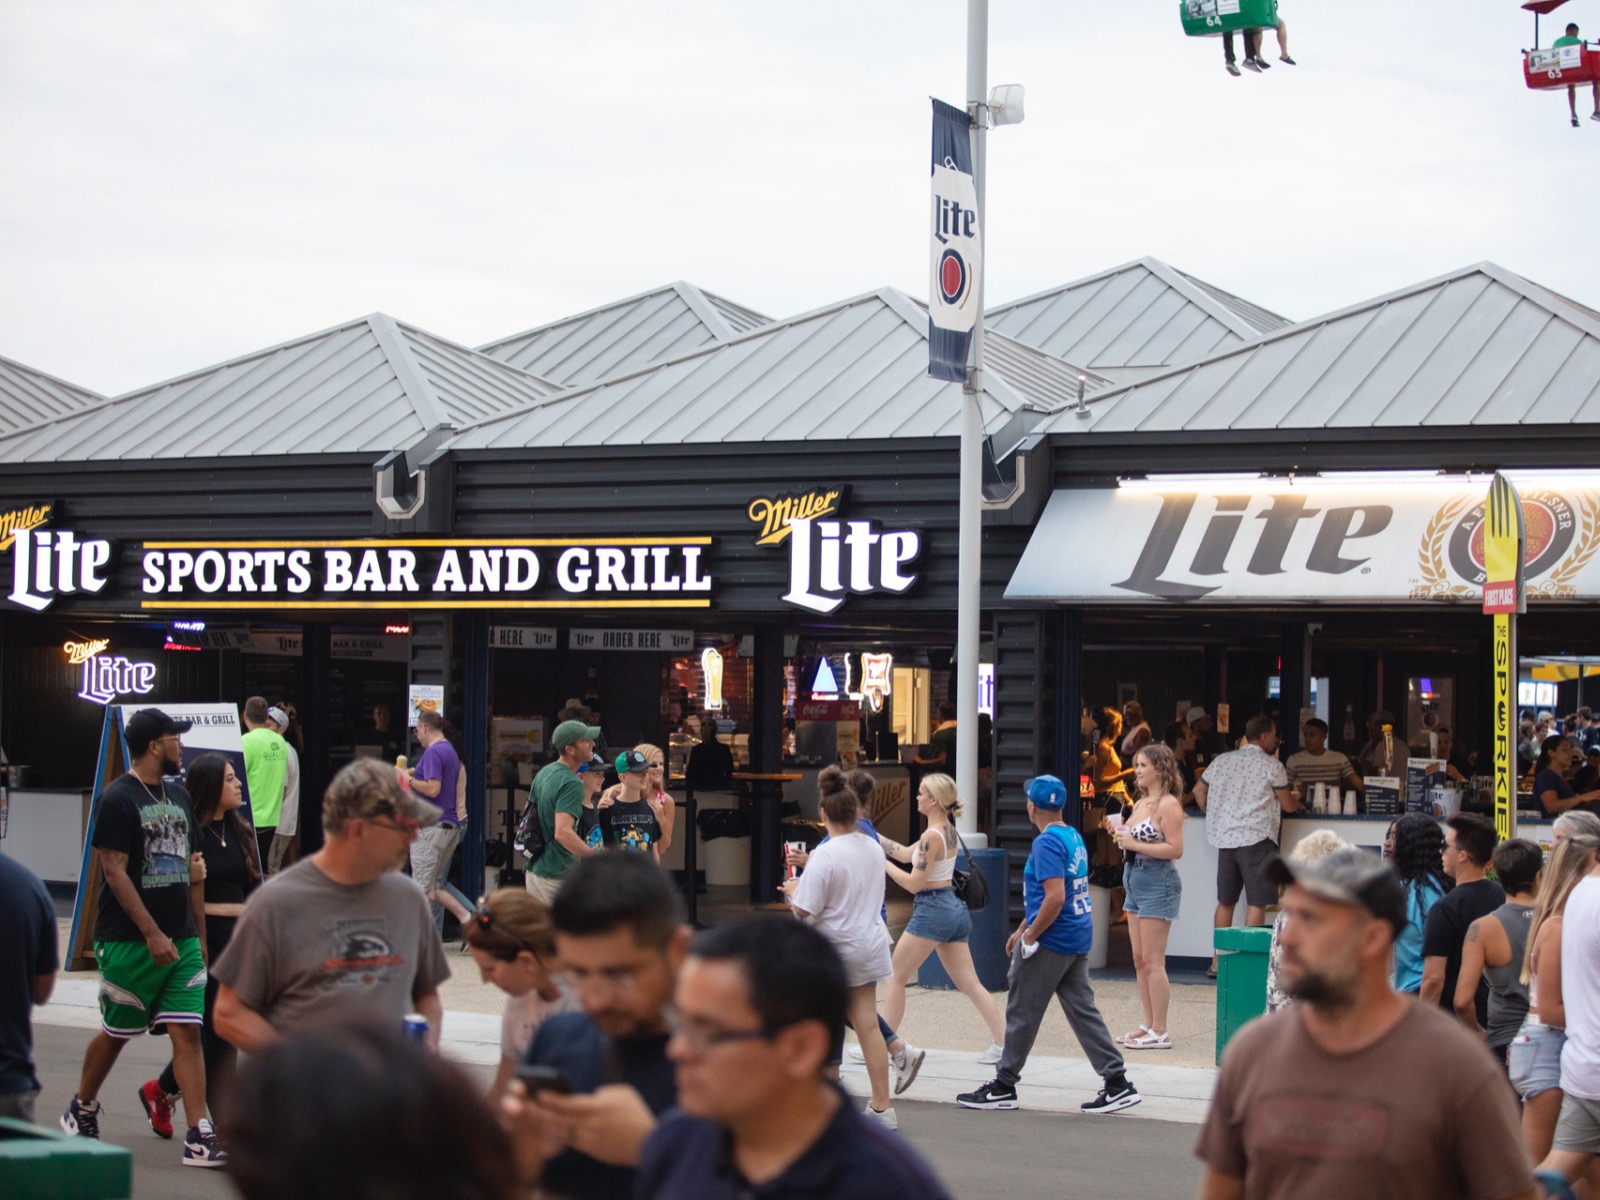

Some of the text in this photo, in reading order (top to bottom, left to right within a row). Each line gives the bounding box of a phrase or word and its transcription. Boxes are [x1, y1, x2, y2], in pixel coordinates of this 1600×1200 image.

[1206, 16, 1222, 27] 64
[1547, 69, 1562, 80] 65
[934, 193, 976, 245] Lite
[749, 490, 838, 545] Miller
[1111, 492, 1394, 600] Lite
[8, 529, 110, 610] Lite
[143, 547, 712, 593] SPORTS BAR AND GRILL
[782, 519, 918, 612] Lite
[1485, 587, 1514, 607] FIRST PLACE
[500, 629, 524, 645] HERE
[535, 630, 553, 644] Lite
[576, 631, 690, 648] Lite ORDER HERE Lite
[1497, 625, 1506, 637] THE
[78, 655, 156, 705] Lite
[978, 674, 994, 708] it
[205, 715, 211, 725] &
[212, 714, 236, 726] GRILL
[1073, 876, 1092, 916] 22
